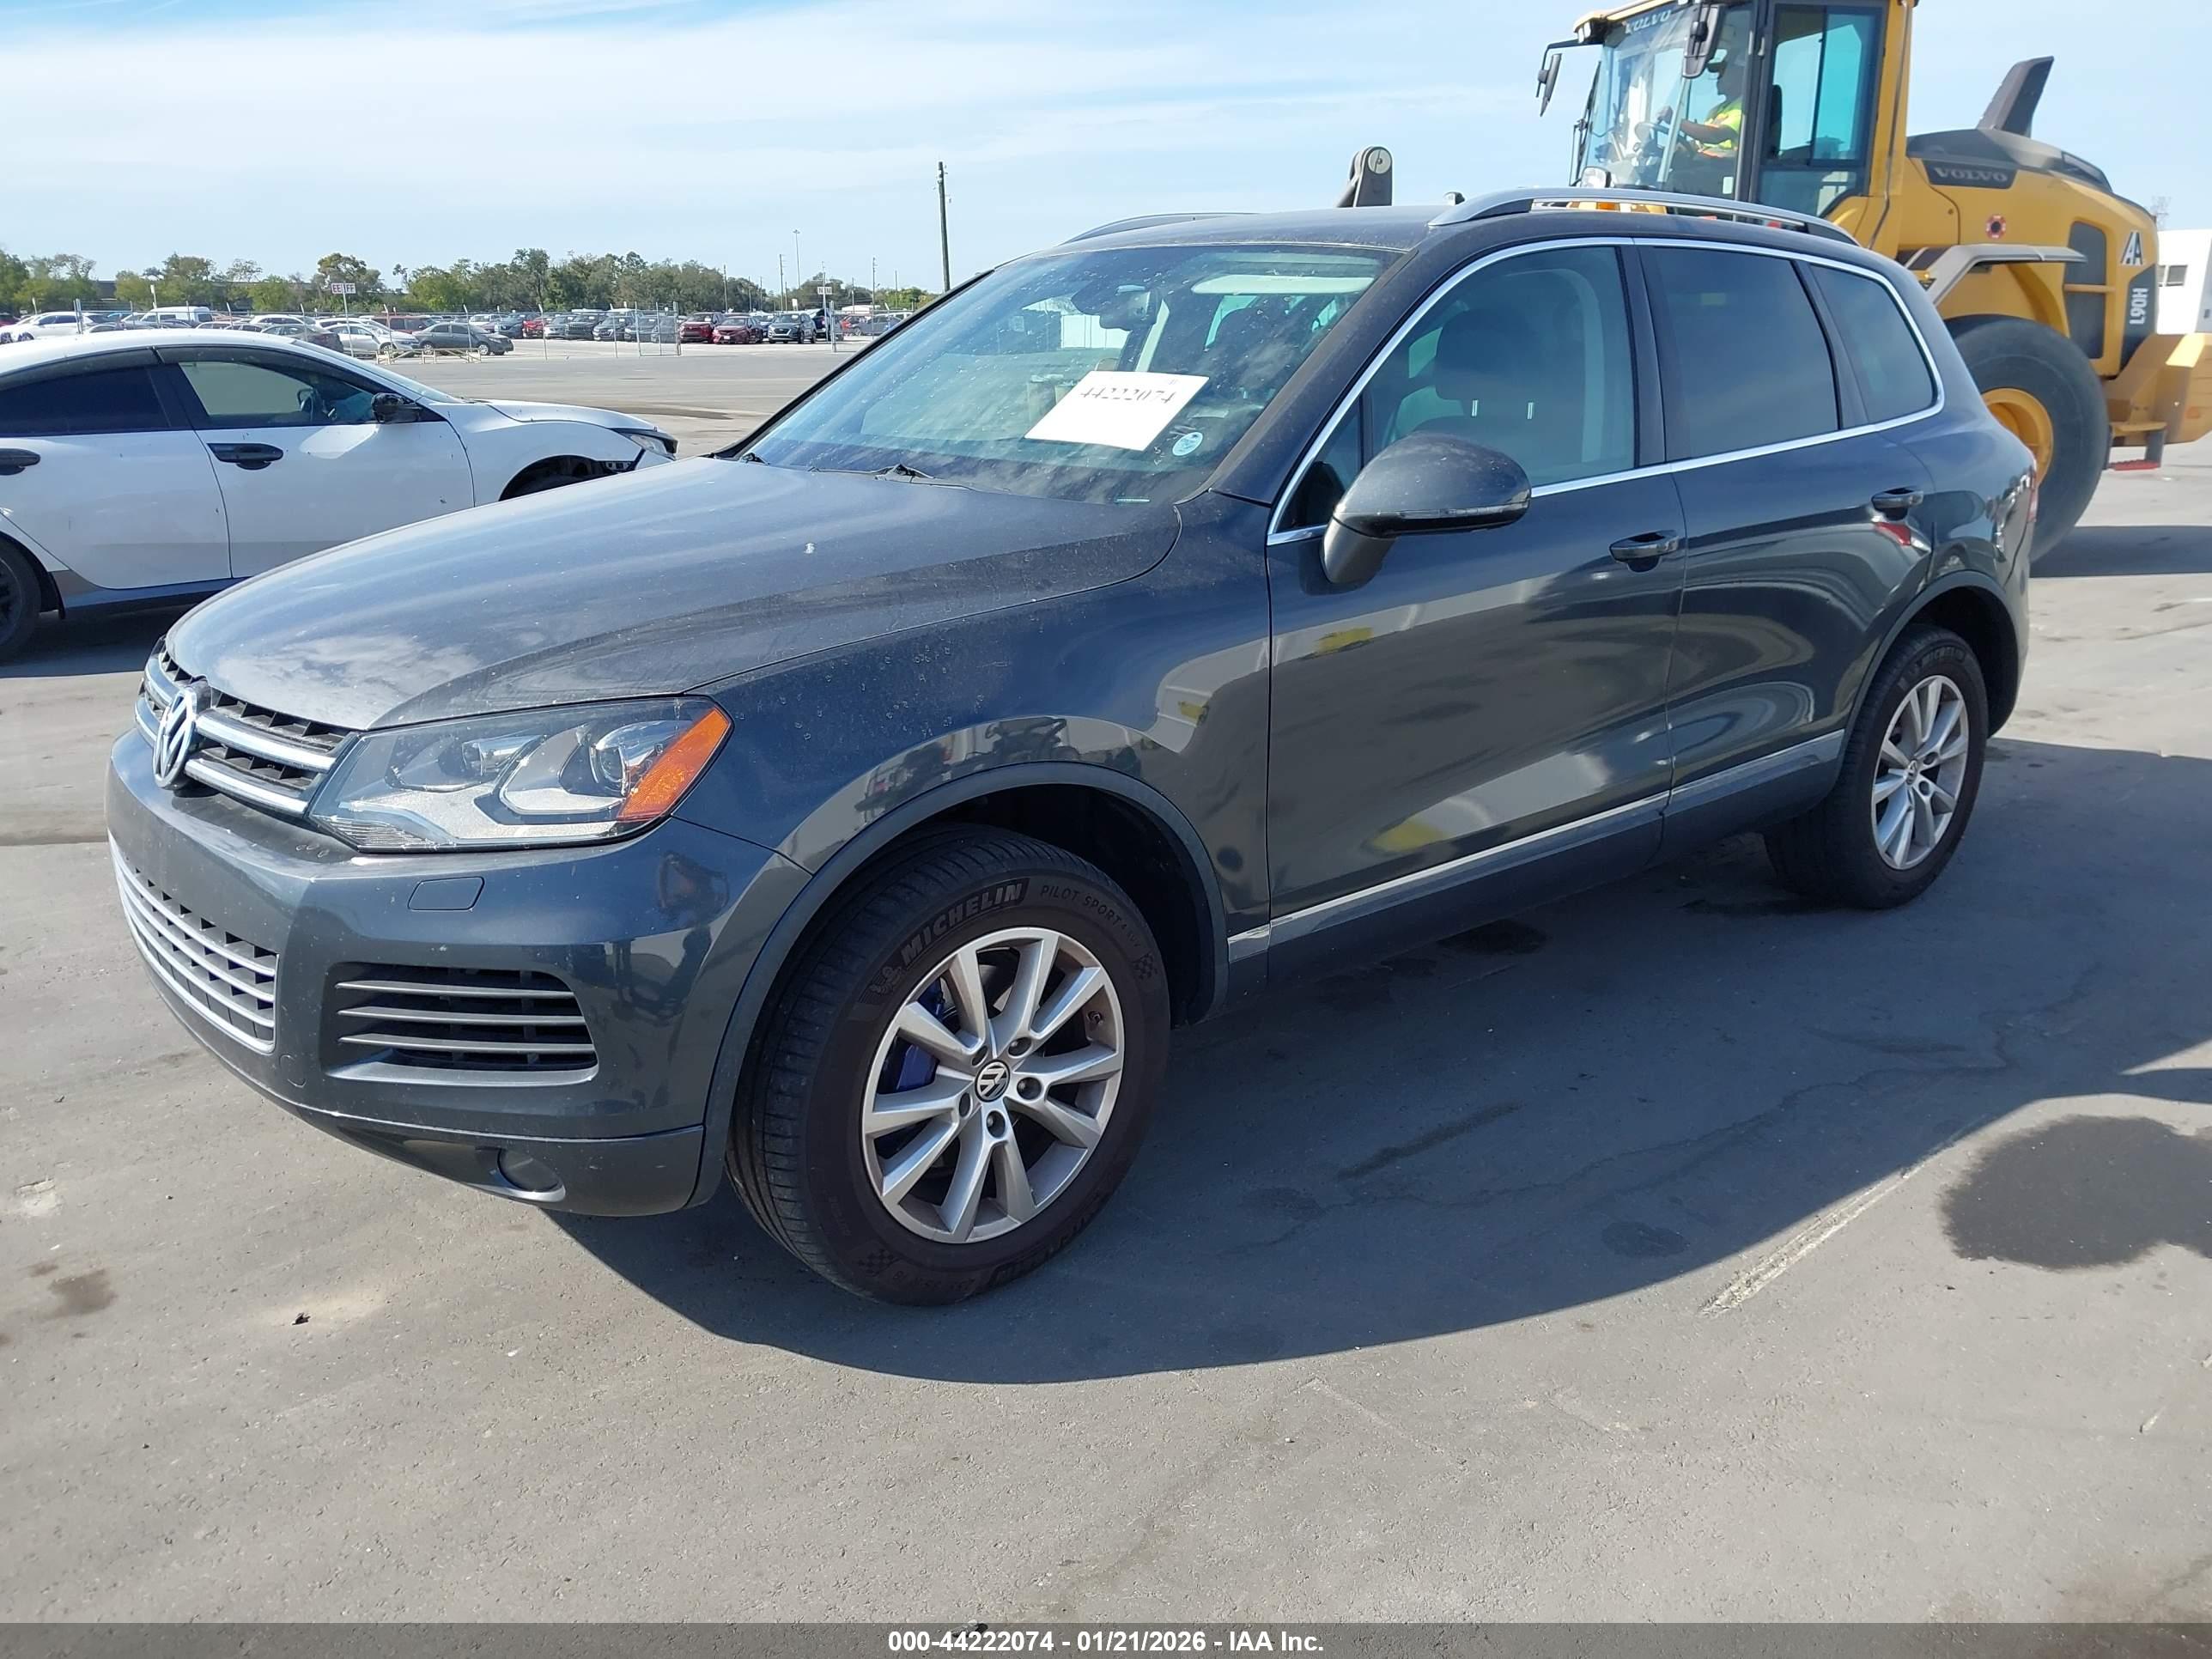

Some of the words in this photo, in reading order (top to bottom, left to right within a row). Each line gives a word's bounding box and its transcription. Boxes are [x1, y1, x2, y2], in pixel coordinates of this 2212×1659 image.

[1934, 167, 2008, 182] VOLVO
[2130, 288, 2148, 325] L90H
[1080, 386, 1176, 404] 44222074
[902, 883, 1023, 965] MICHELIN
[1040, 885, 1079, 901] PILOT
[1083, 895, 1122, 926] SPORT
